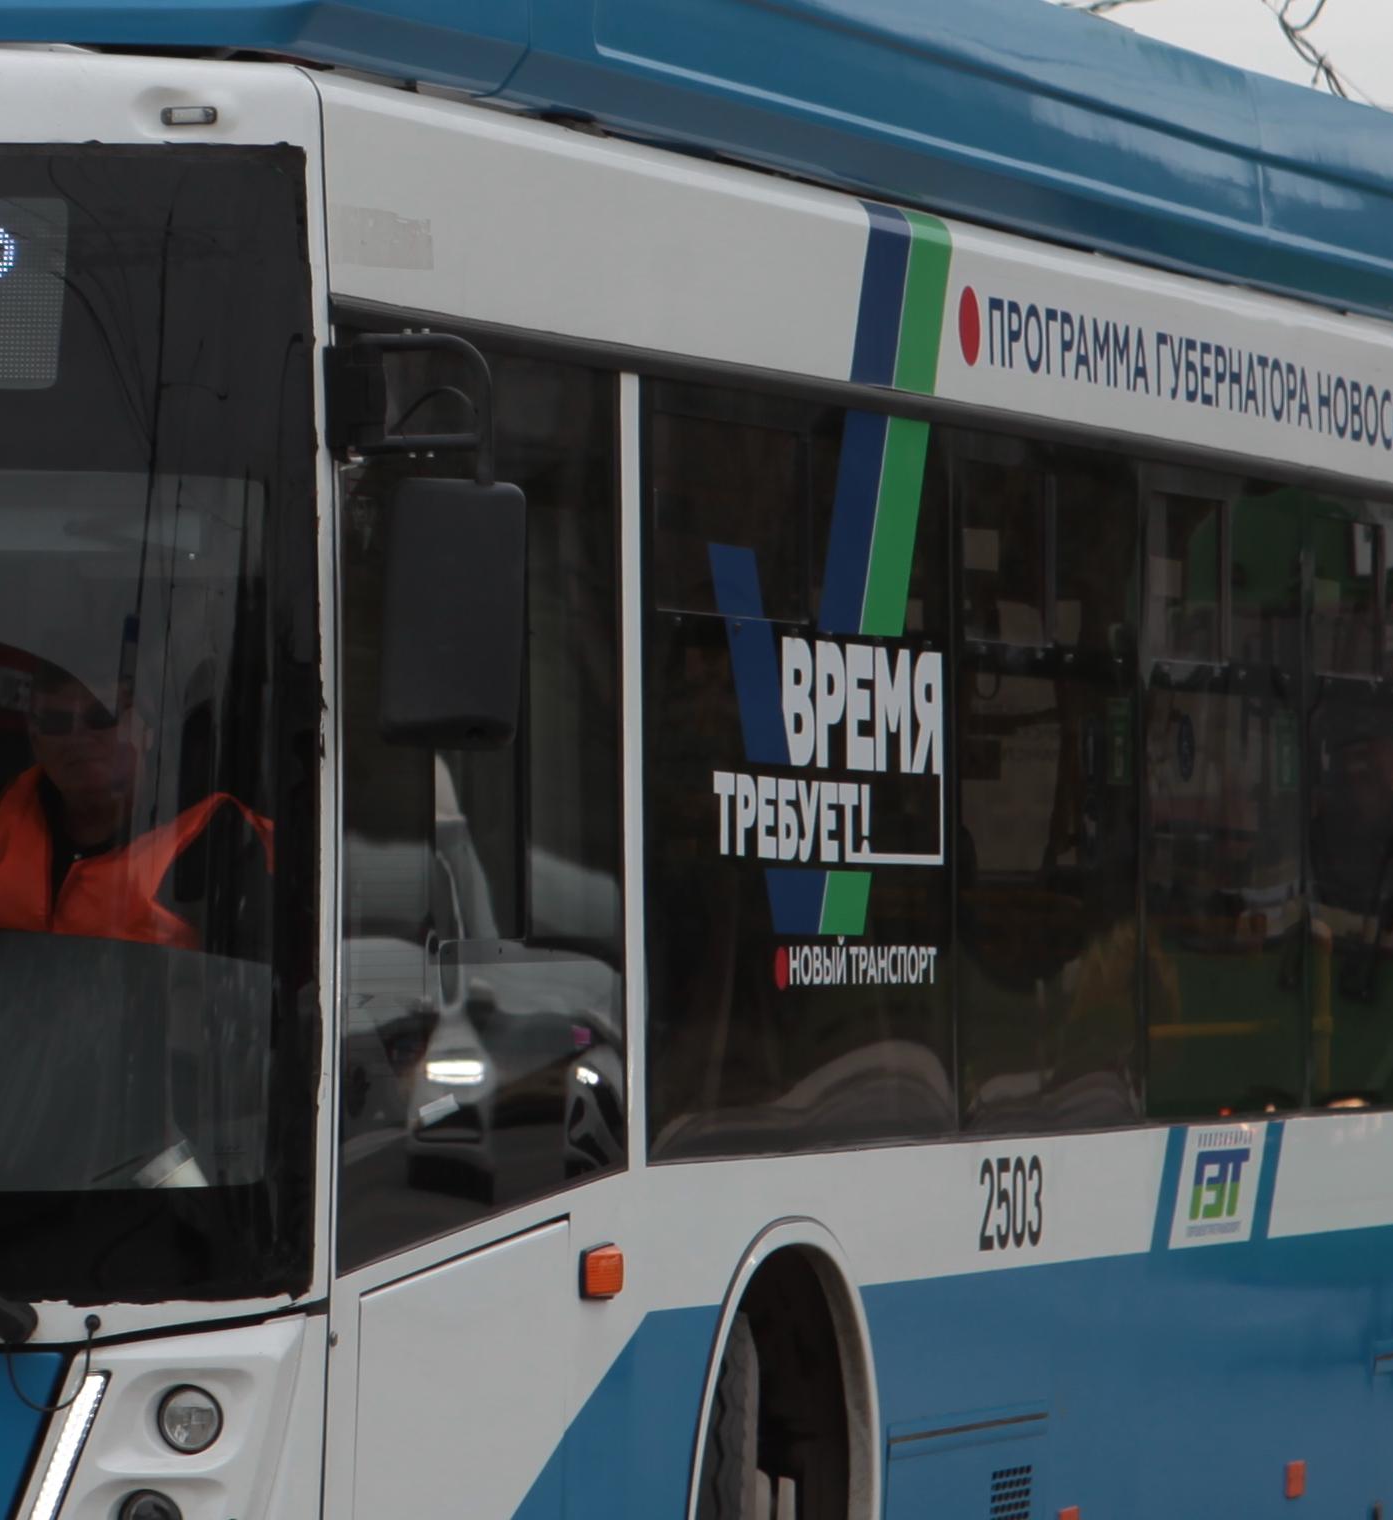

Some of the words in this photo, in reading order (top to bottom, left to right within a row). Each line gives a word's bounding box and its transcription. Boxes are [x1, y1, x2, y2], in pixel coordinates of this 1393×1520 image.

[988, 296, 1150, 395] ПРОГРАММА
[1156, 331, 1313, 432] ГУБЕРНАТОРА
[781, 635, 943, 775] ВРЕМЯ
[713, 770, 874, 864] ТРЕБУЕТ!
[788, 935, 847, 986] НОВЫЙ
[848, 945, 938, 985] ТРАНСПОРТ
[978, 1154, 1044, 1252] 2503
